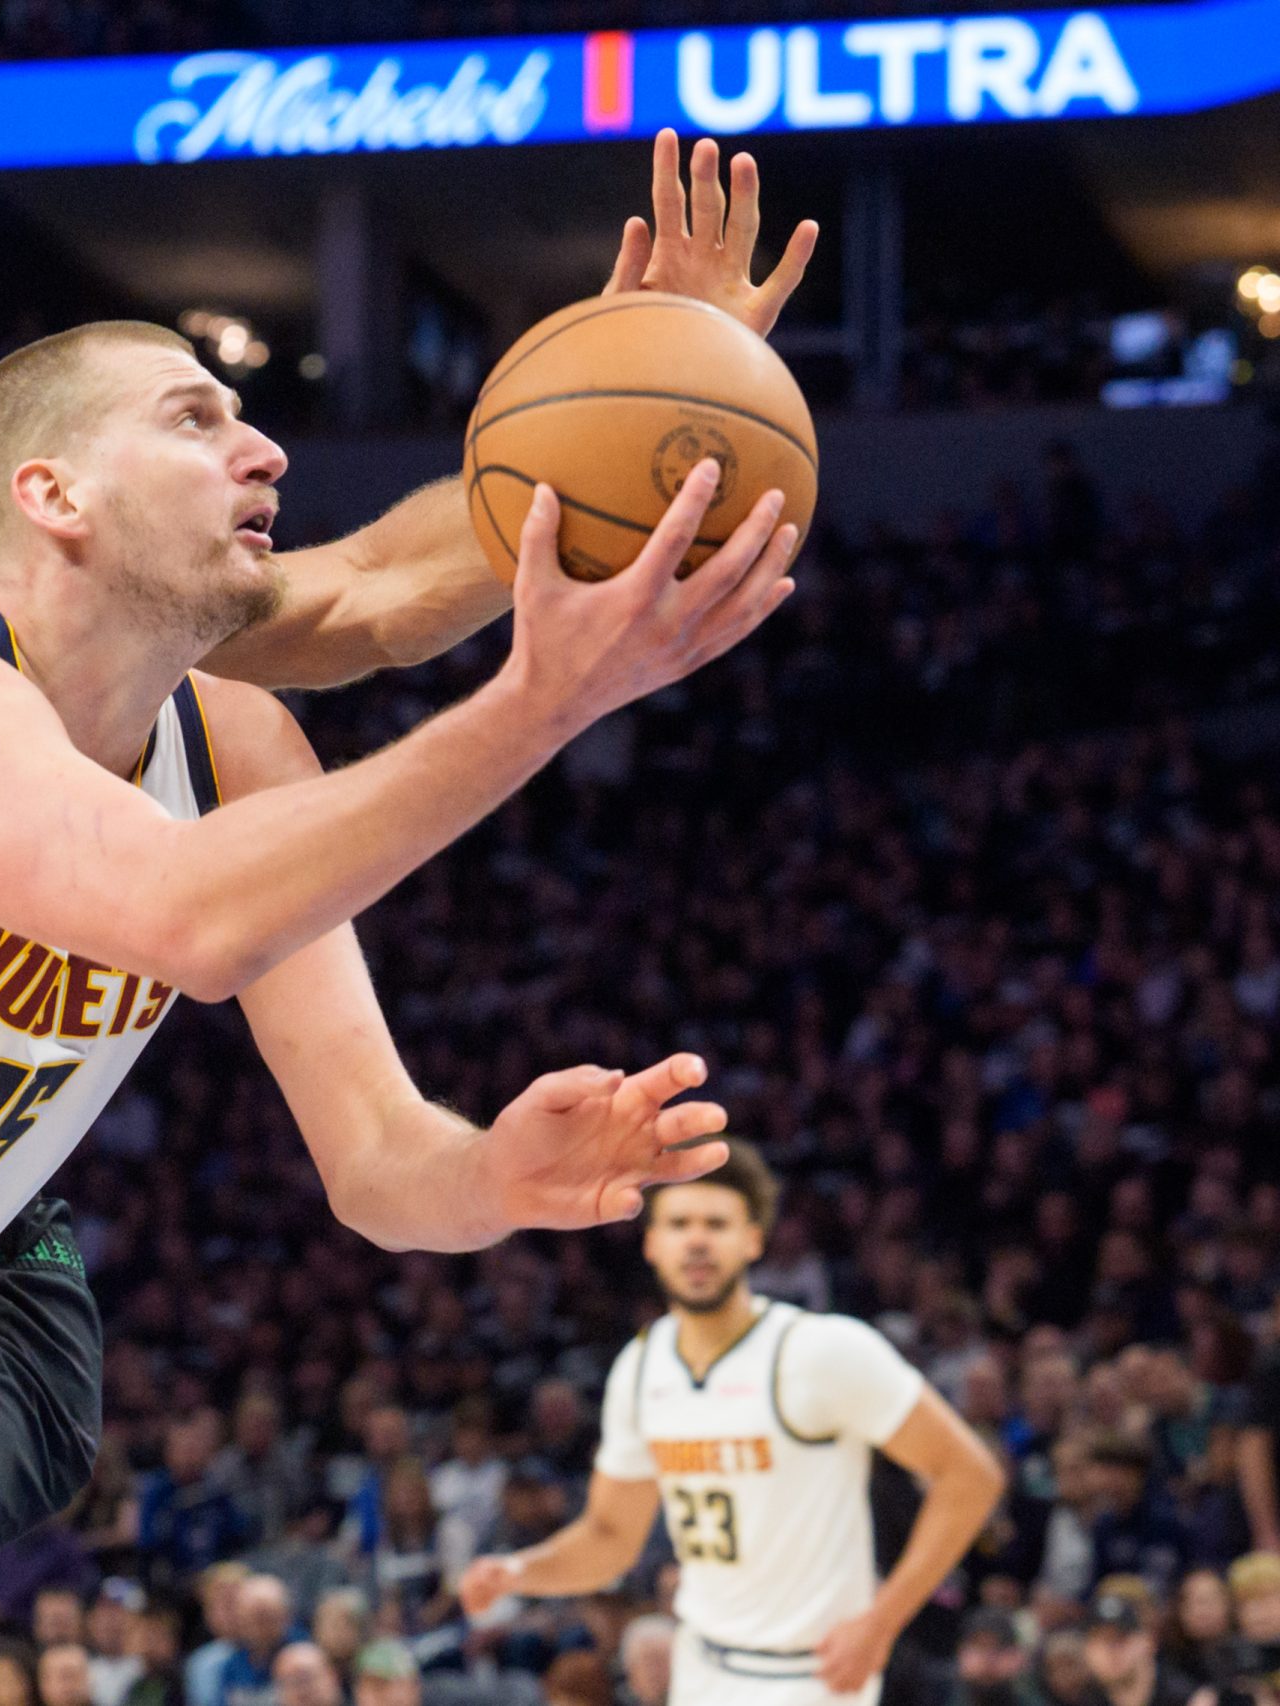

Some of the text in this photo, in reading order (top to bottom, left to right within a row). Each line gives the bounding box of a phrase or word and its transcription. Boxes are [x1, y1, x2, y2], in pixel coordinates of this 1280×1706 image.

[132, 11, 1140, 165] Michelob ULTRA
[673, 1486, 740, 1564] 23
